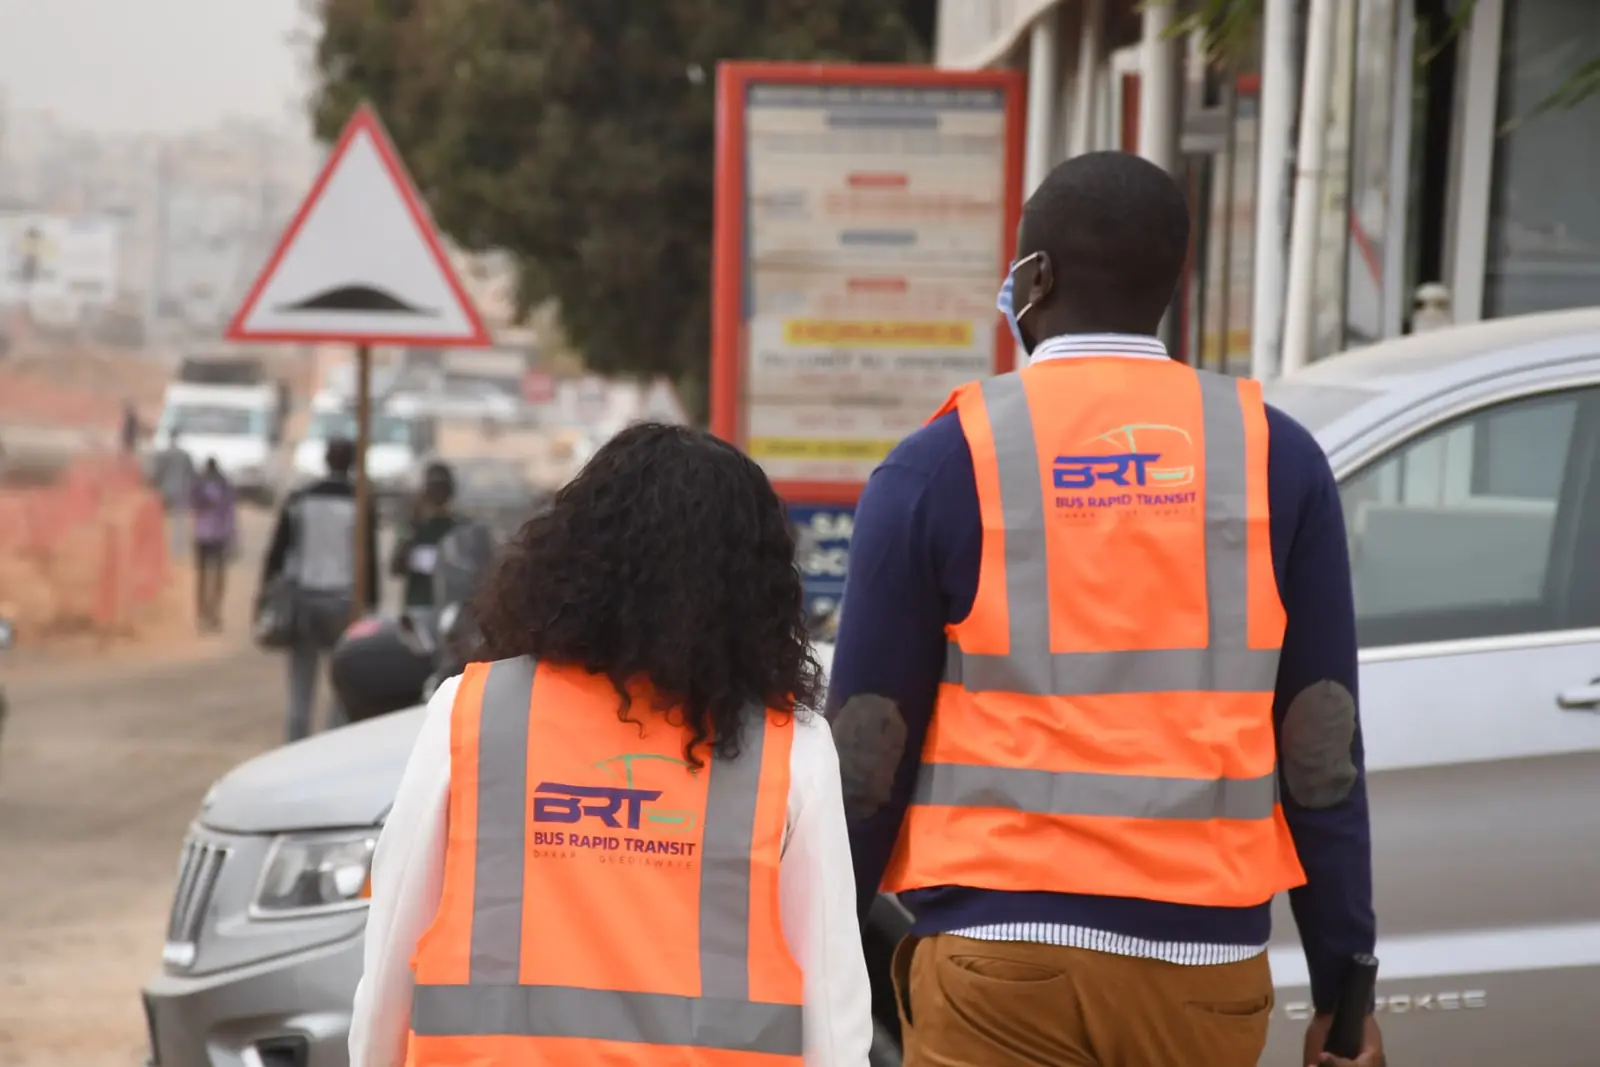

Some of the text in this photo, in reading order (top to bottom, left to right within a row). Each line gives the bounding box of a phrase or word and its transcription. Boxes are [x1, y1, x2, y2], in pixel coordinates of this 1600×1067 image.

[1053, 453, 1162, 488] BRT
[1055, 492, 1196, 508] BUS RAPID TRANSIT
[533, 782, 663, 830] BRT
[534, 832, 696, 856] BUS RAPID TRANSIT
